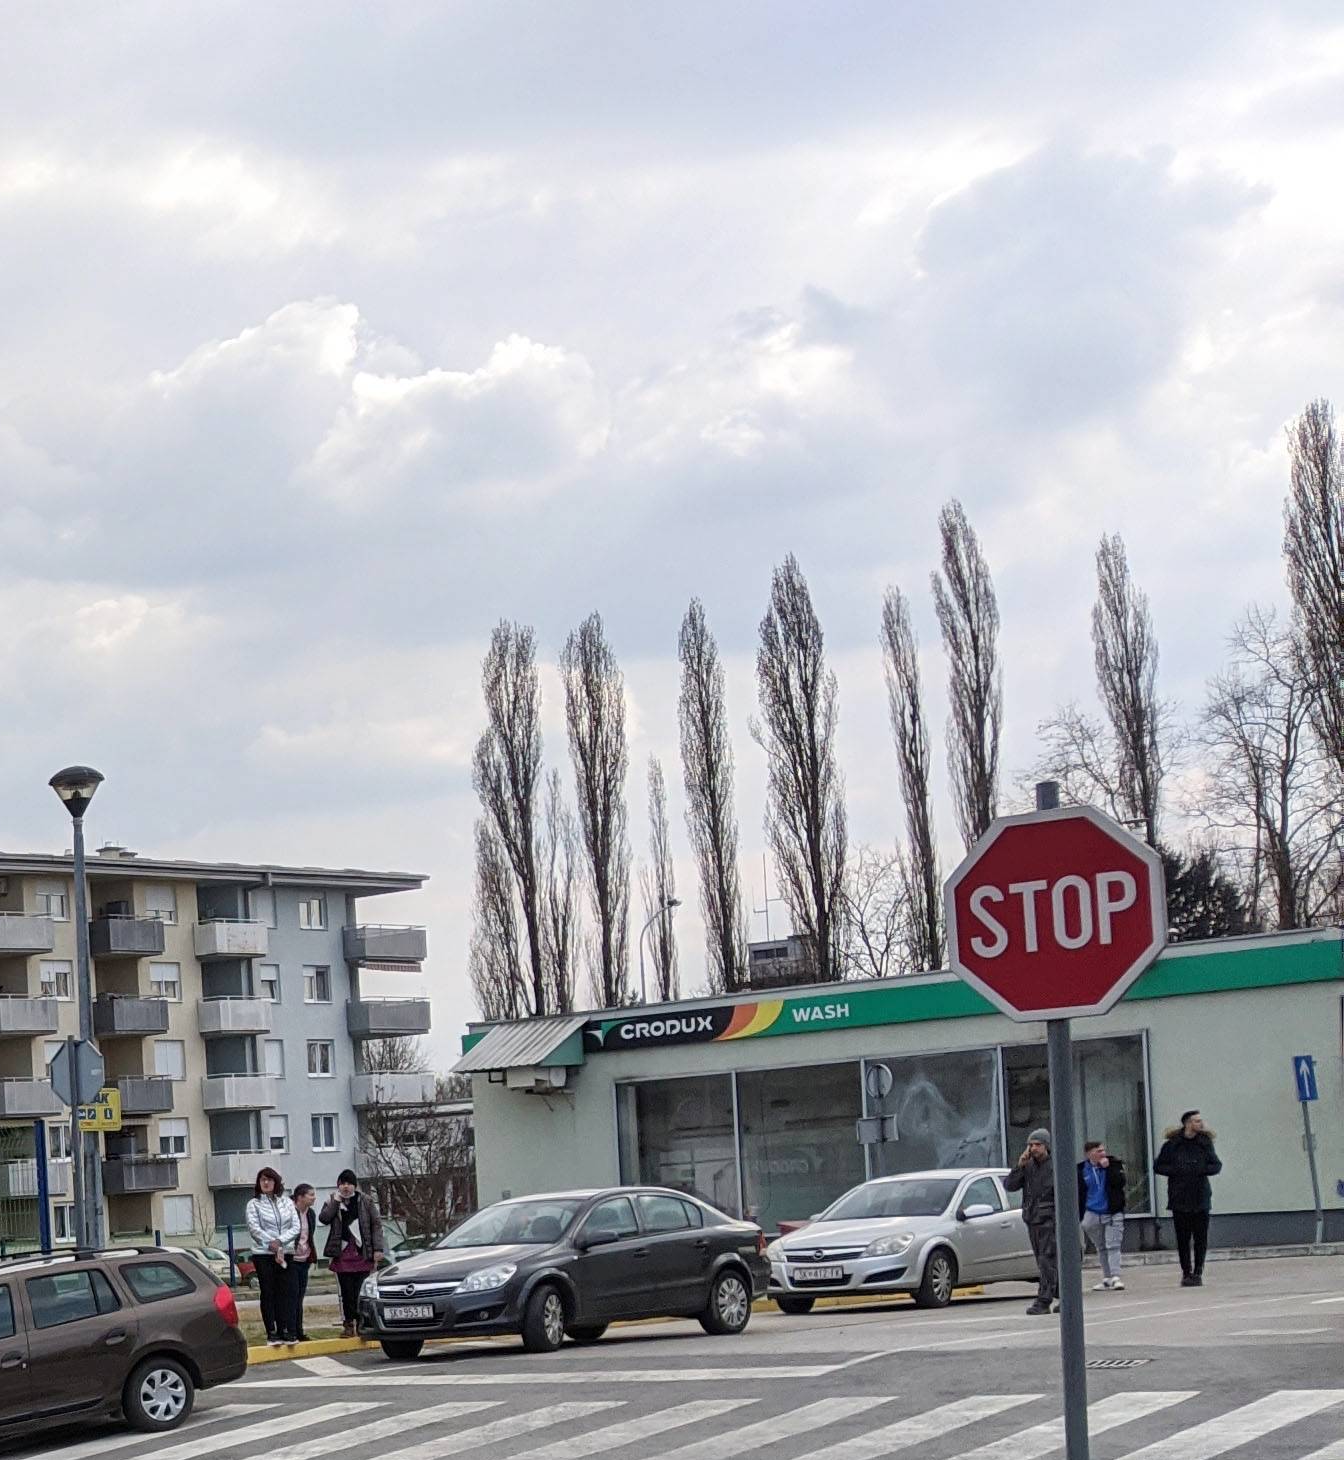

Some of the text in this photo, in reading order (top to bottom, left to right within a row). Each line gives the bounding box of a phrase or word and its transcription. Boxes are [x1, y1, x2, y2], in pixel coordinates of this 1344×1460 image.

[969, 870, 1138, 959] STOP
[619, 1002, 850, 1041] CRODUX WASH
